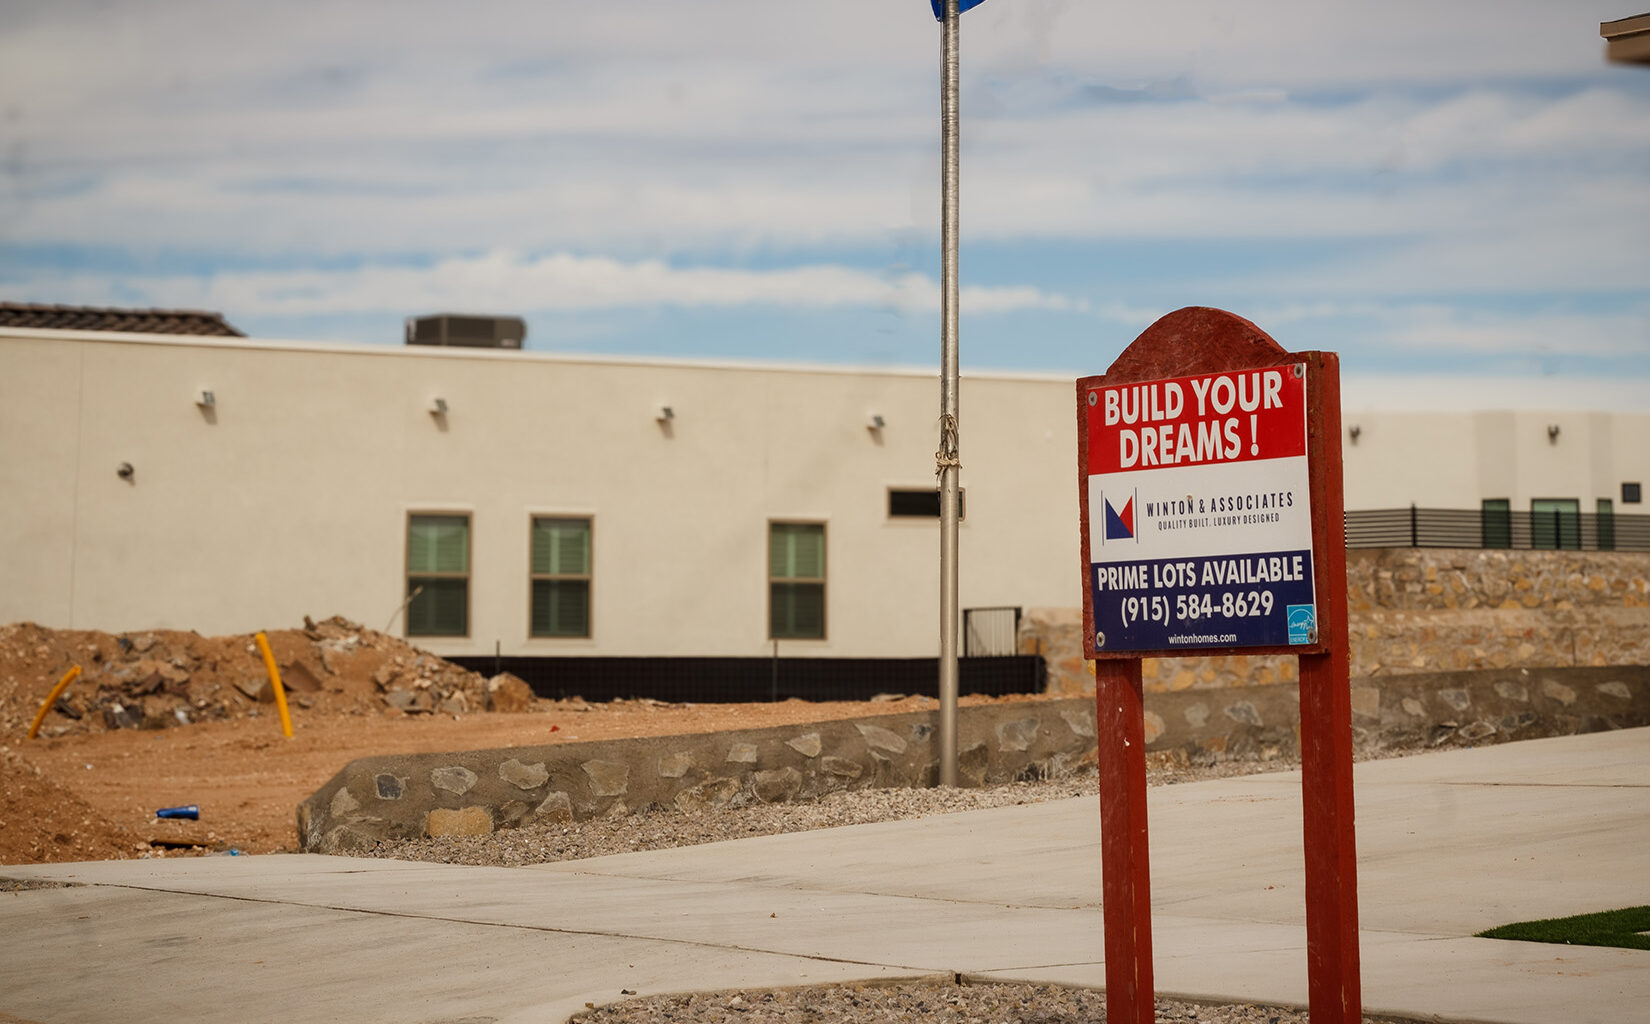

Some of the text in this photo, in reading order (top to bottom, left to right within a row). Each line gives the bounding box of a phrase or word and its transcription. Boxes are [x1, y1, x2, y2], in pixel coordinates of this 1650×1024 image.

[1104, 370, 1284, 426] BUILD YOUR
[1146, 491, 1293, 517] WINTON & ASSOCIATES
[1158, 519, 1188, 531] QUALITY
[1213, 514, 1242, 527] LUXURY
[1243, 512, 1280, 525] DESIGNED
[1097, 555, 1304, 591] PRIME LOTS AVAILABLE
[1121, 590, 1274, 628] (915) 584-8629
[1168, 632, 1237, 645] wintonhomes.com
